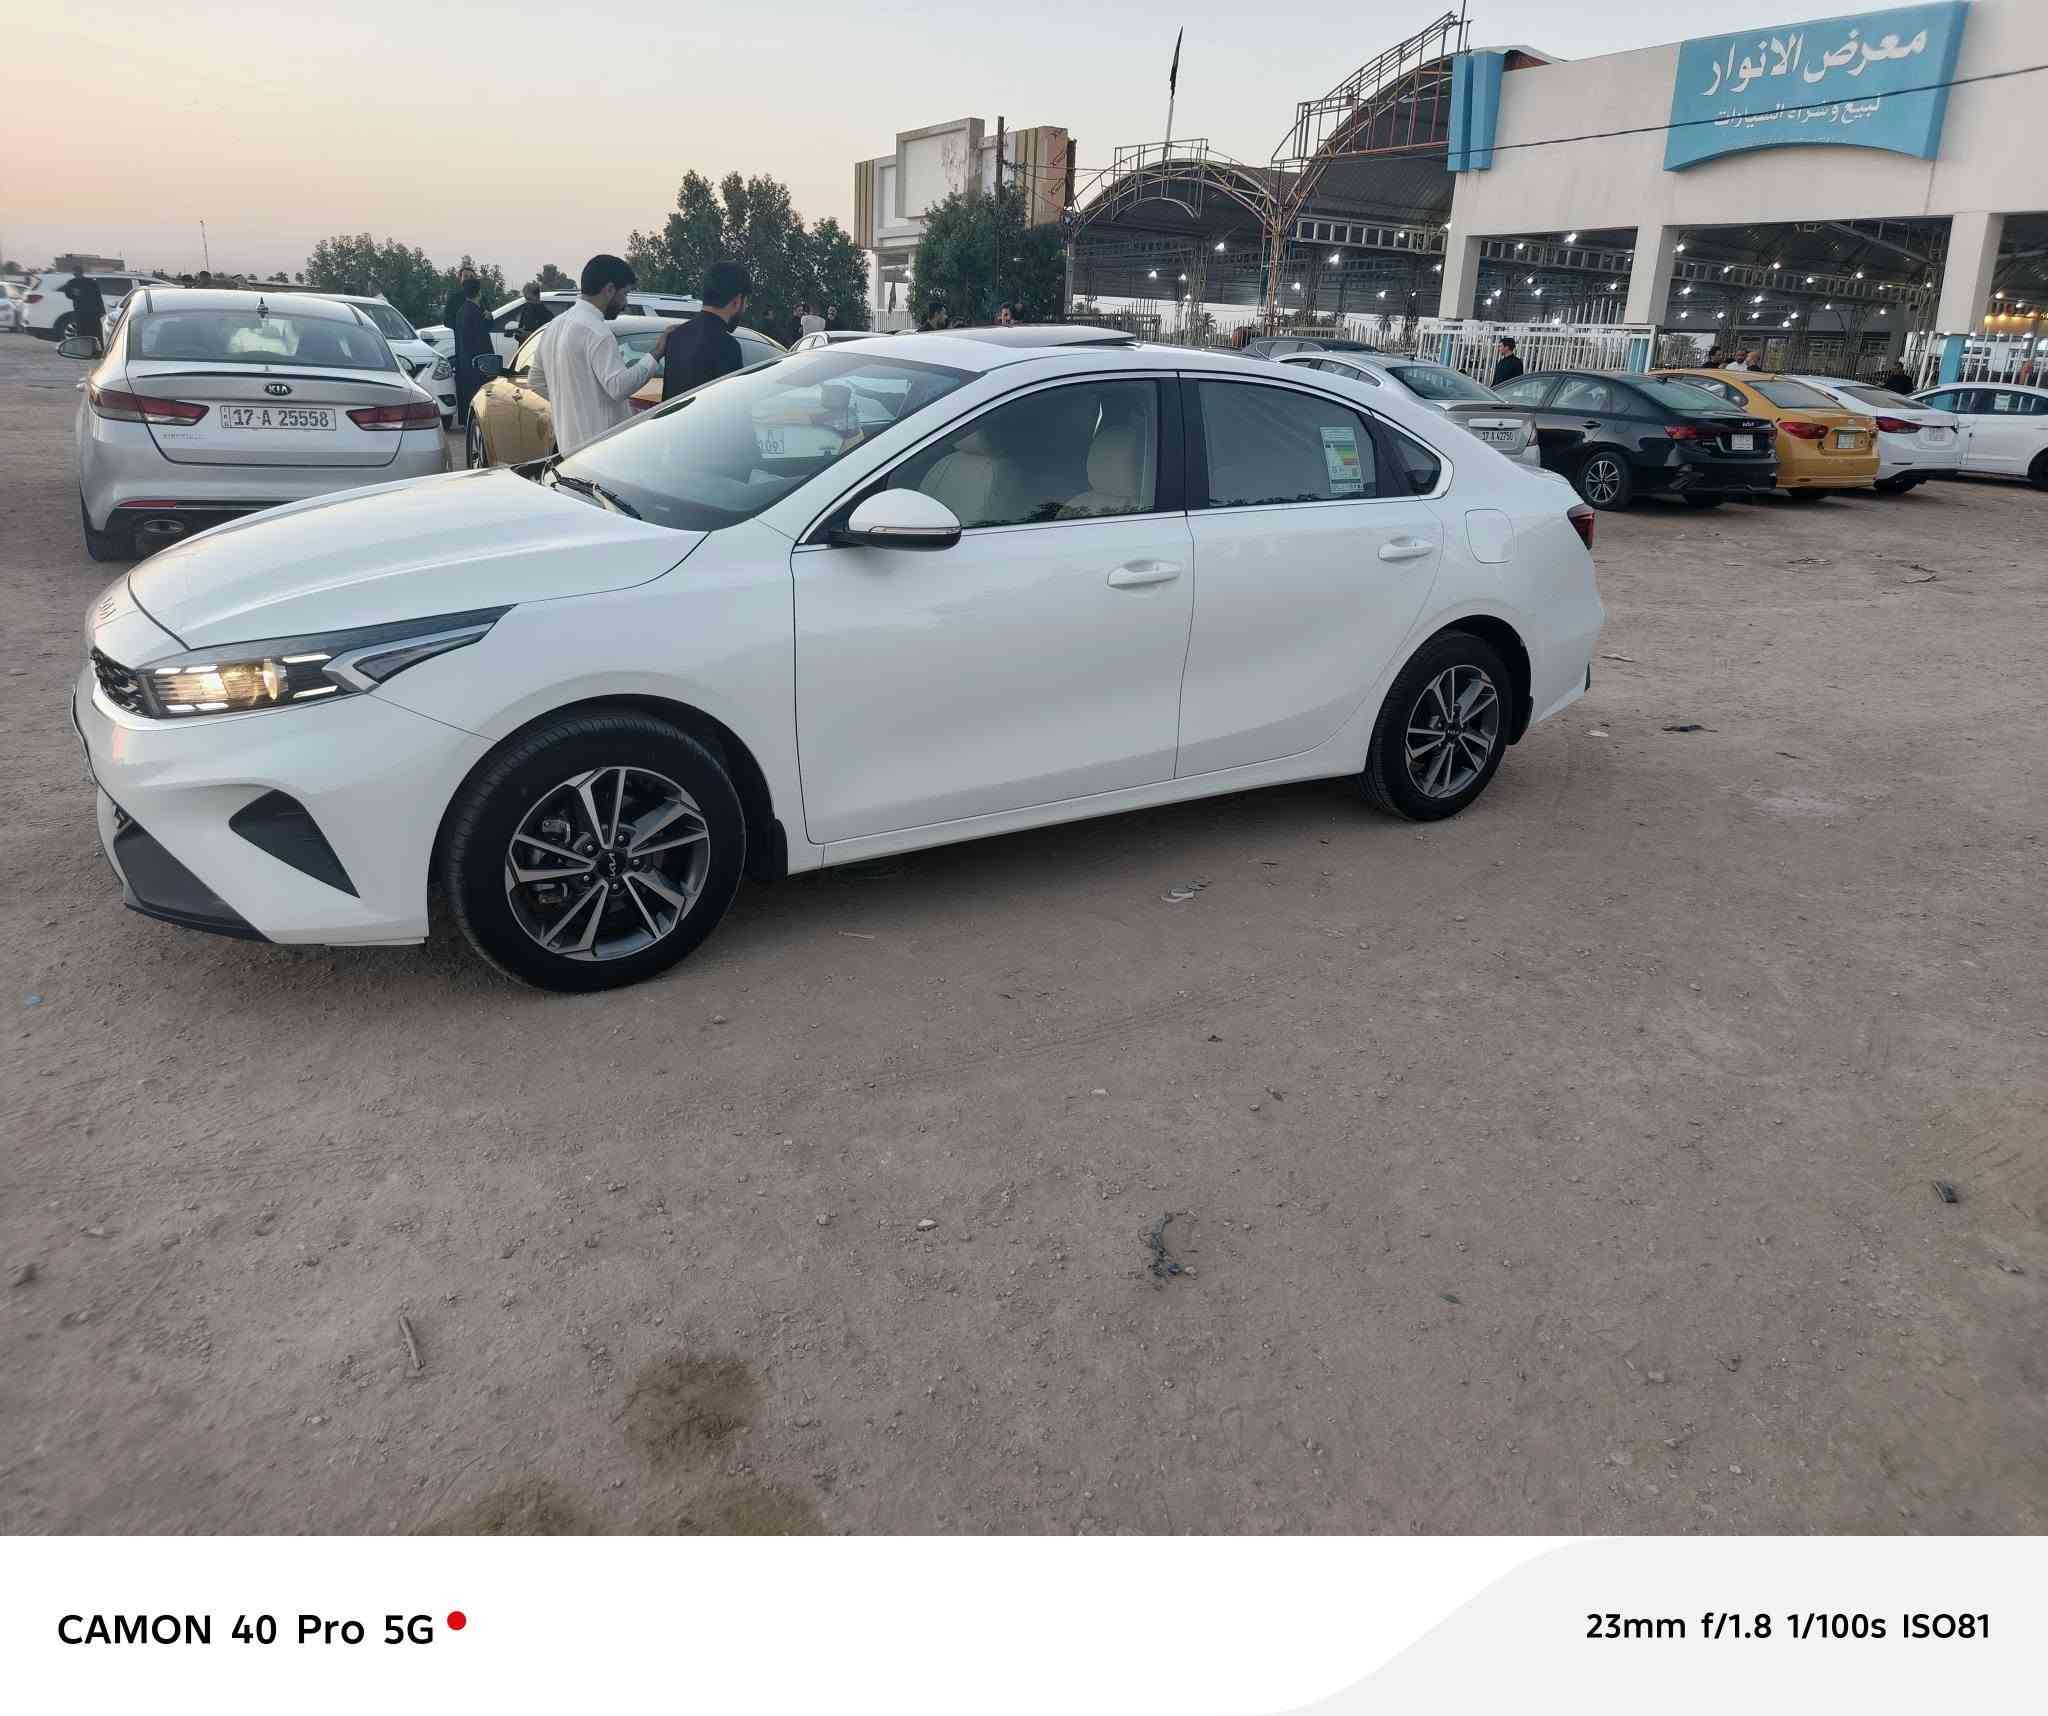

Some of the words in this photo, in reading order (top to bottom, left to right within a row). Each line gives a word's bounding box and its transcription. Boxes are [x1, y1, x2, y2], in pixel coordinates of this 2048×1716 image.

[1702, 32, 1804, 96] الانوار
[1803, 28, 1928, 84] معرض
[1841, 96, 1881, 124] لبيع
[268, 384, 289, 394] KIA
[278, 409, 329, 428] 25558
